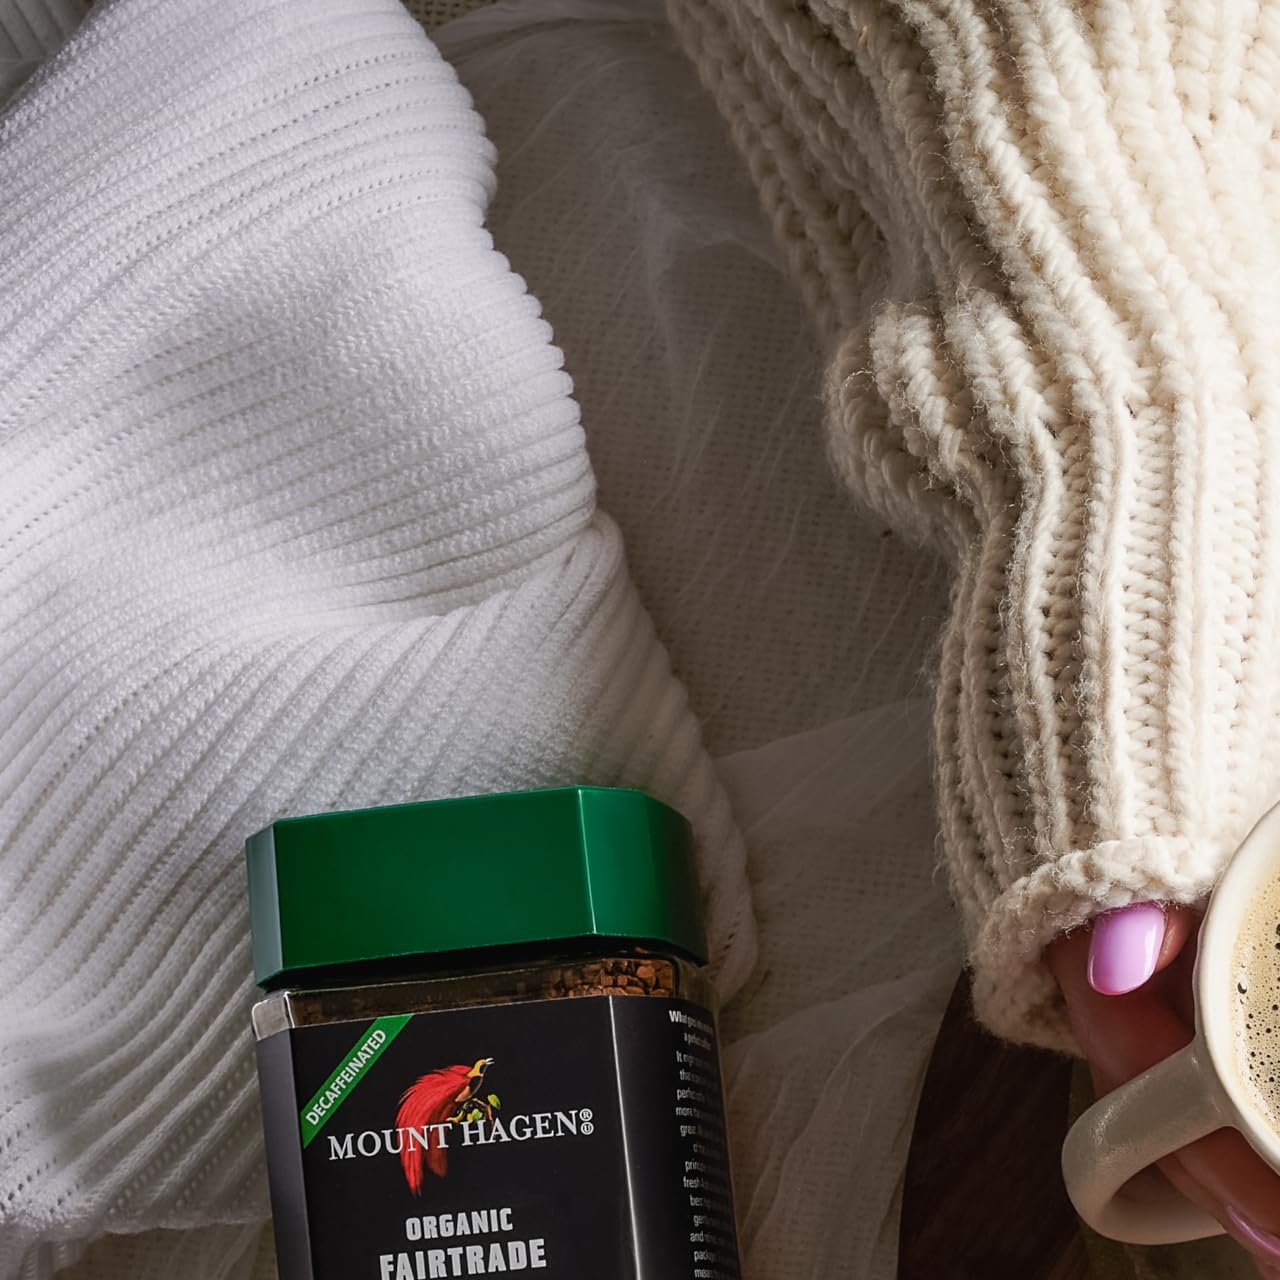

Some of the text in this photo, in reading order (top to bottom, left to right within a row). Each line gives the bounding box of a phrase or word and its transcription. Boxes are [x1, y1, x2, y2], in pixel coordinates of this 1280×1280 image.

[306, 1029, 386, 1126] DECAFFEINATED
[328, 1110, 578, 1160] MOUNT HAGEN
[405, 1208, 513, 1241] ORGANIC
